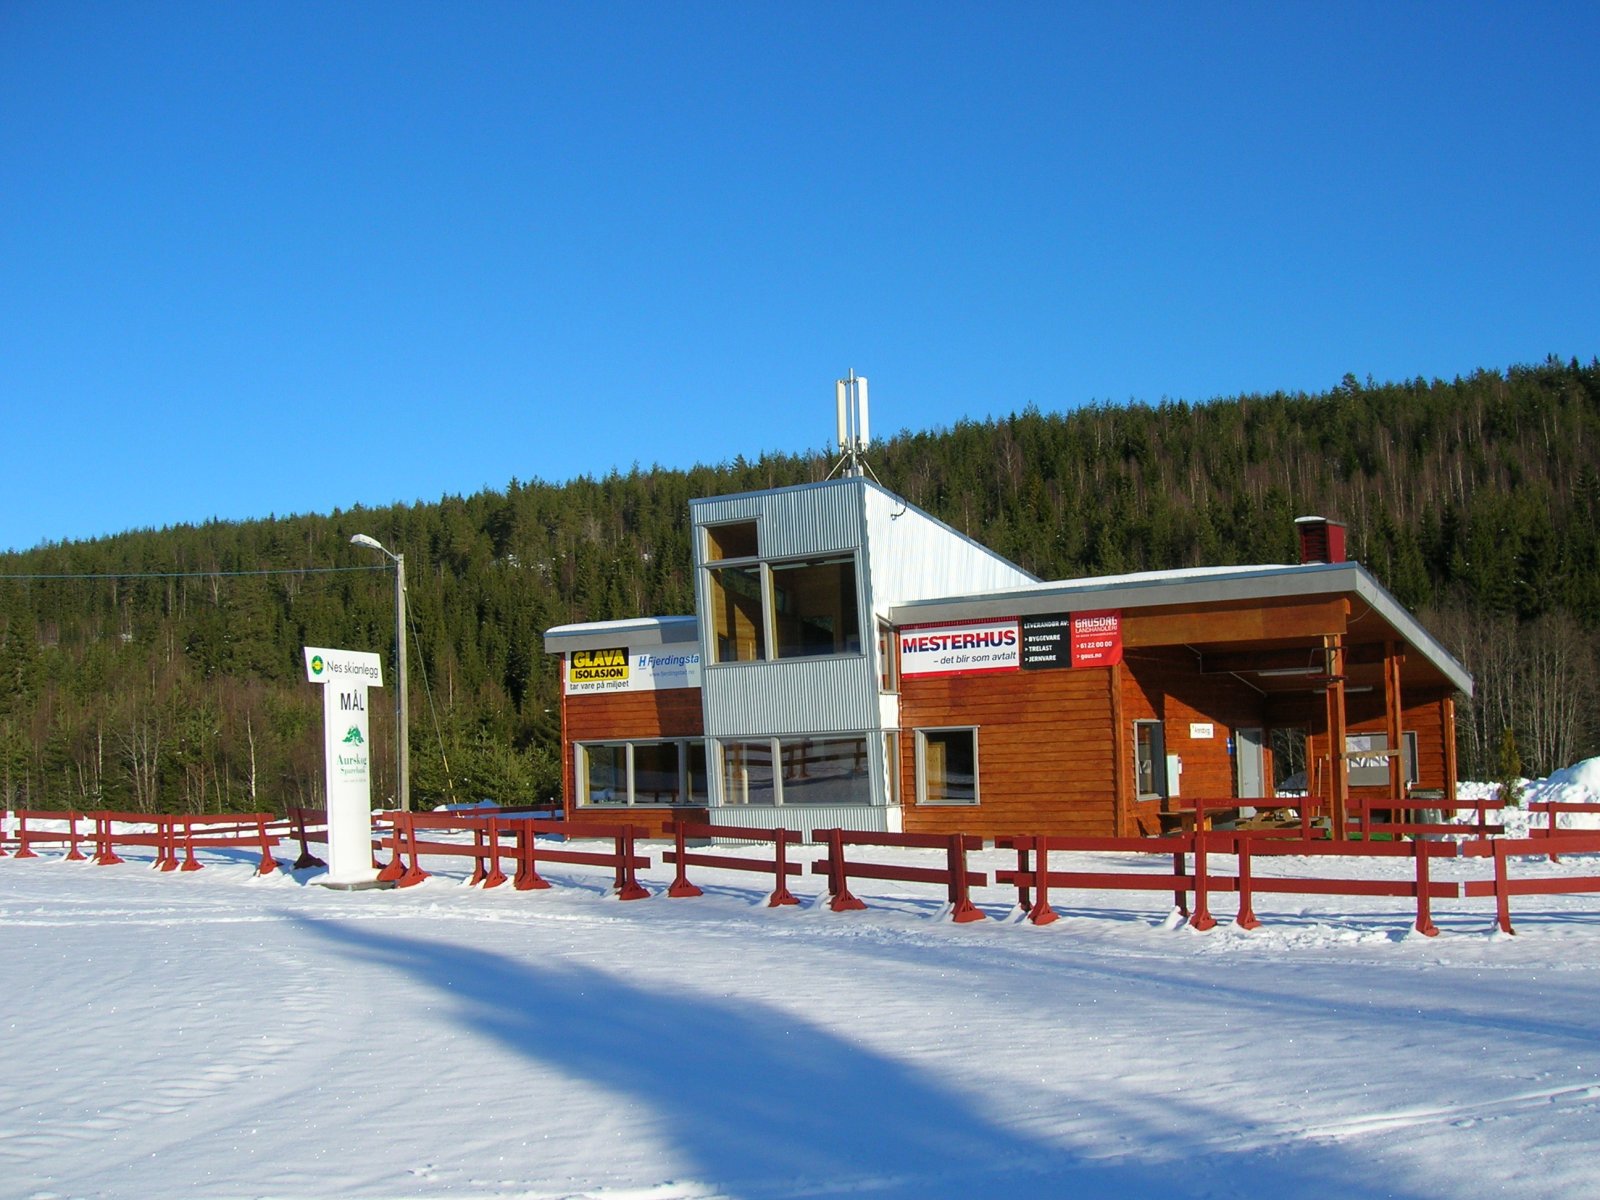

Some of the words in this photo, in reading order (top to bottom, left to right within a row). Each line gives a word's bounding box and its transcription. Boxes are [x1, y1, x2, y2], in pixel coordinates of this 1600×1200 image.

[1075, 616, 1117, 628] GAUSDAL
[903, 630, 1016, 653] MESTERHUS
[1028, 634, 1060, 642] BYGGEVARE
[574, 649, 625, 667] GLAVA
[940, 656, 954, 664] det
[956, 655, 969, 664] blir
[971, 655, 990, 663] som
[991, 651, 1016, 661] avtalt
[327, 661, 342, 672] Nes
[344, 661, 378, 678] skianlegg
[575, 669, 623, 679] ISOLASJON
[581, 682, 595, 690] vare
[596, 680, 605, 690] på
[606, 680, 629, 689] miljøet
[340, 689, 364, 711] MÅL
